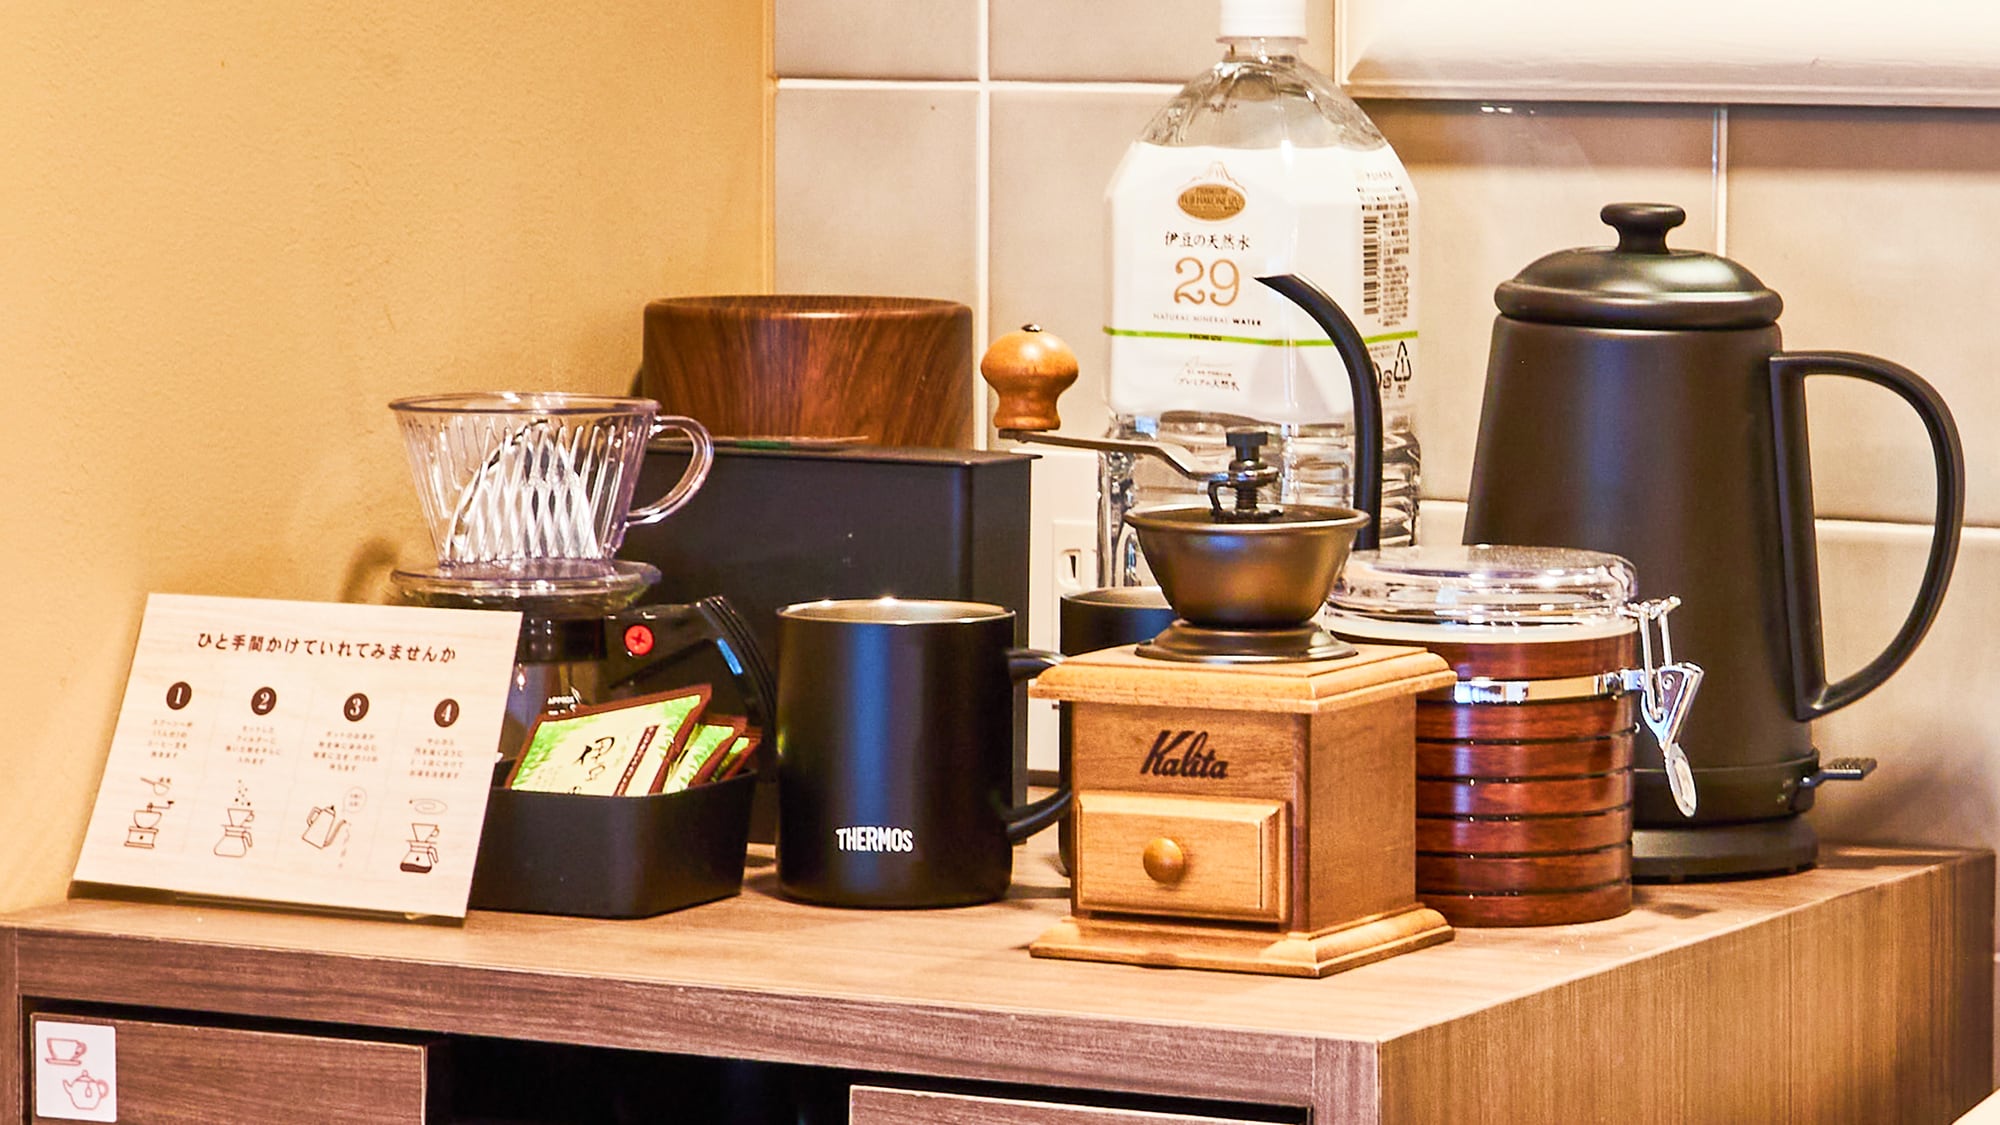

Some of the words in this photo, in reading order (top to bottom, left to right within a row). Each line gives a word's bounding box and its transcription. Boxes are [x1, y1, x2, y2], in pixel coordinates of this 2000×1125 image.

[1165, 231, 1250, 250] 伊豆の天然水
[1174, 256, 1240, 307] 29
[1153, 312, 1189, 322] NATURAL
[1193, 315, 1228, 324] MINERAL
[1232, 318, 1262, 326] WATER
[197, 632, 457, 664] ひと手間かけていれてみませんか
[1140, 729, 1229, 779] Kalita
[836, 826, 913, 853] THERMOS
